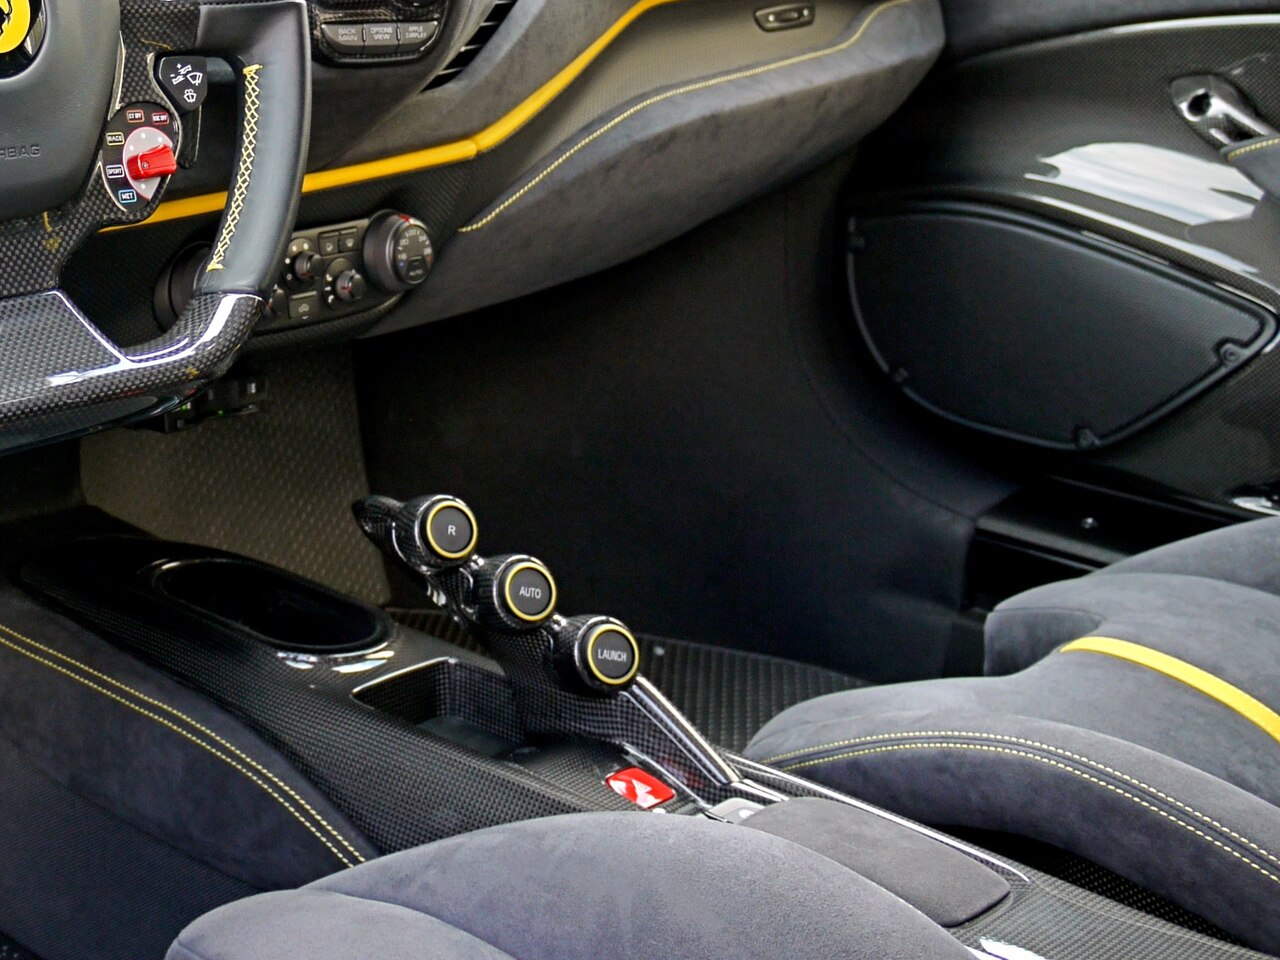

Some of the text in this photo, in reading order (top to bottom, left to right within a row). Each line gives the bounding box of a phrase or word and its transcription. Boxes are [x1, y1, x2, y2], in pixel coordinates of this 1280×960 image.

[121, 191, 133, 199] WET
[447, 524, 456, 536] R
[519, 586, 542, 599] AUTO
[597, 648, 627, 662] LAUNCH
